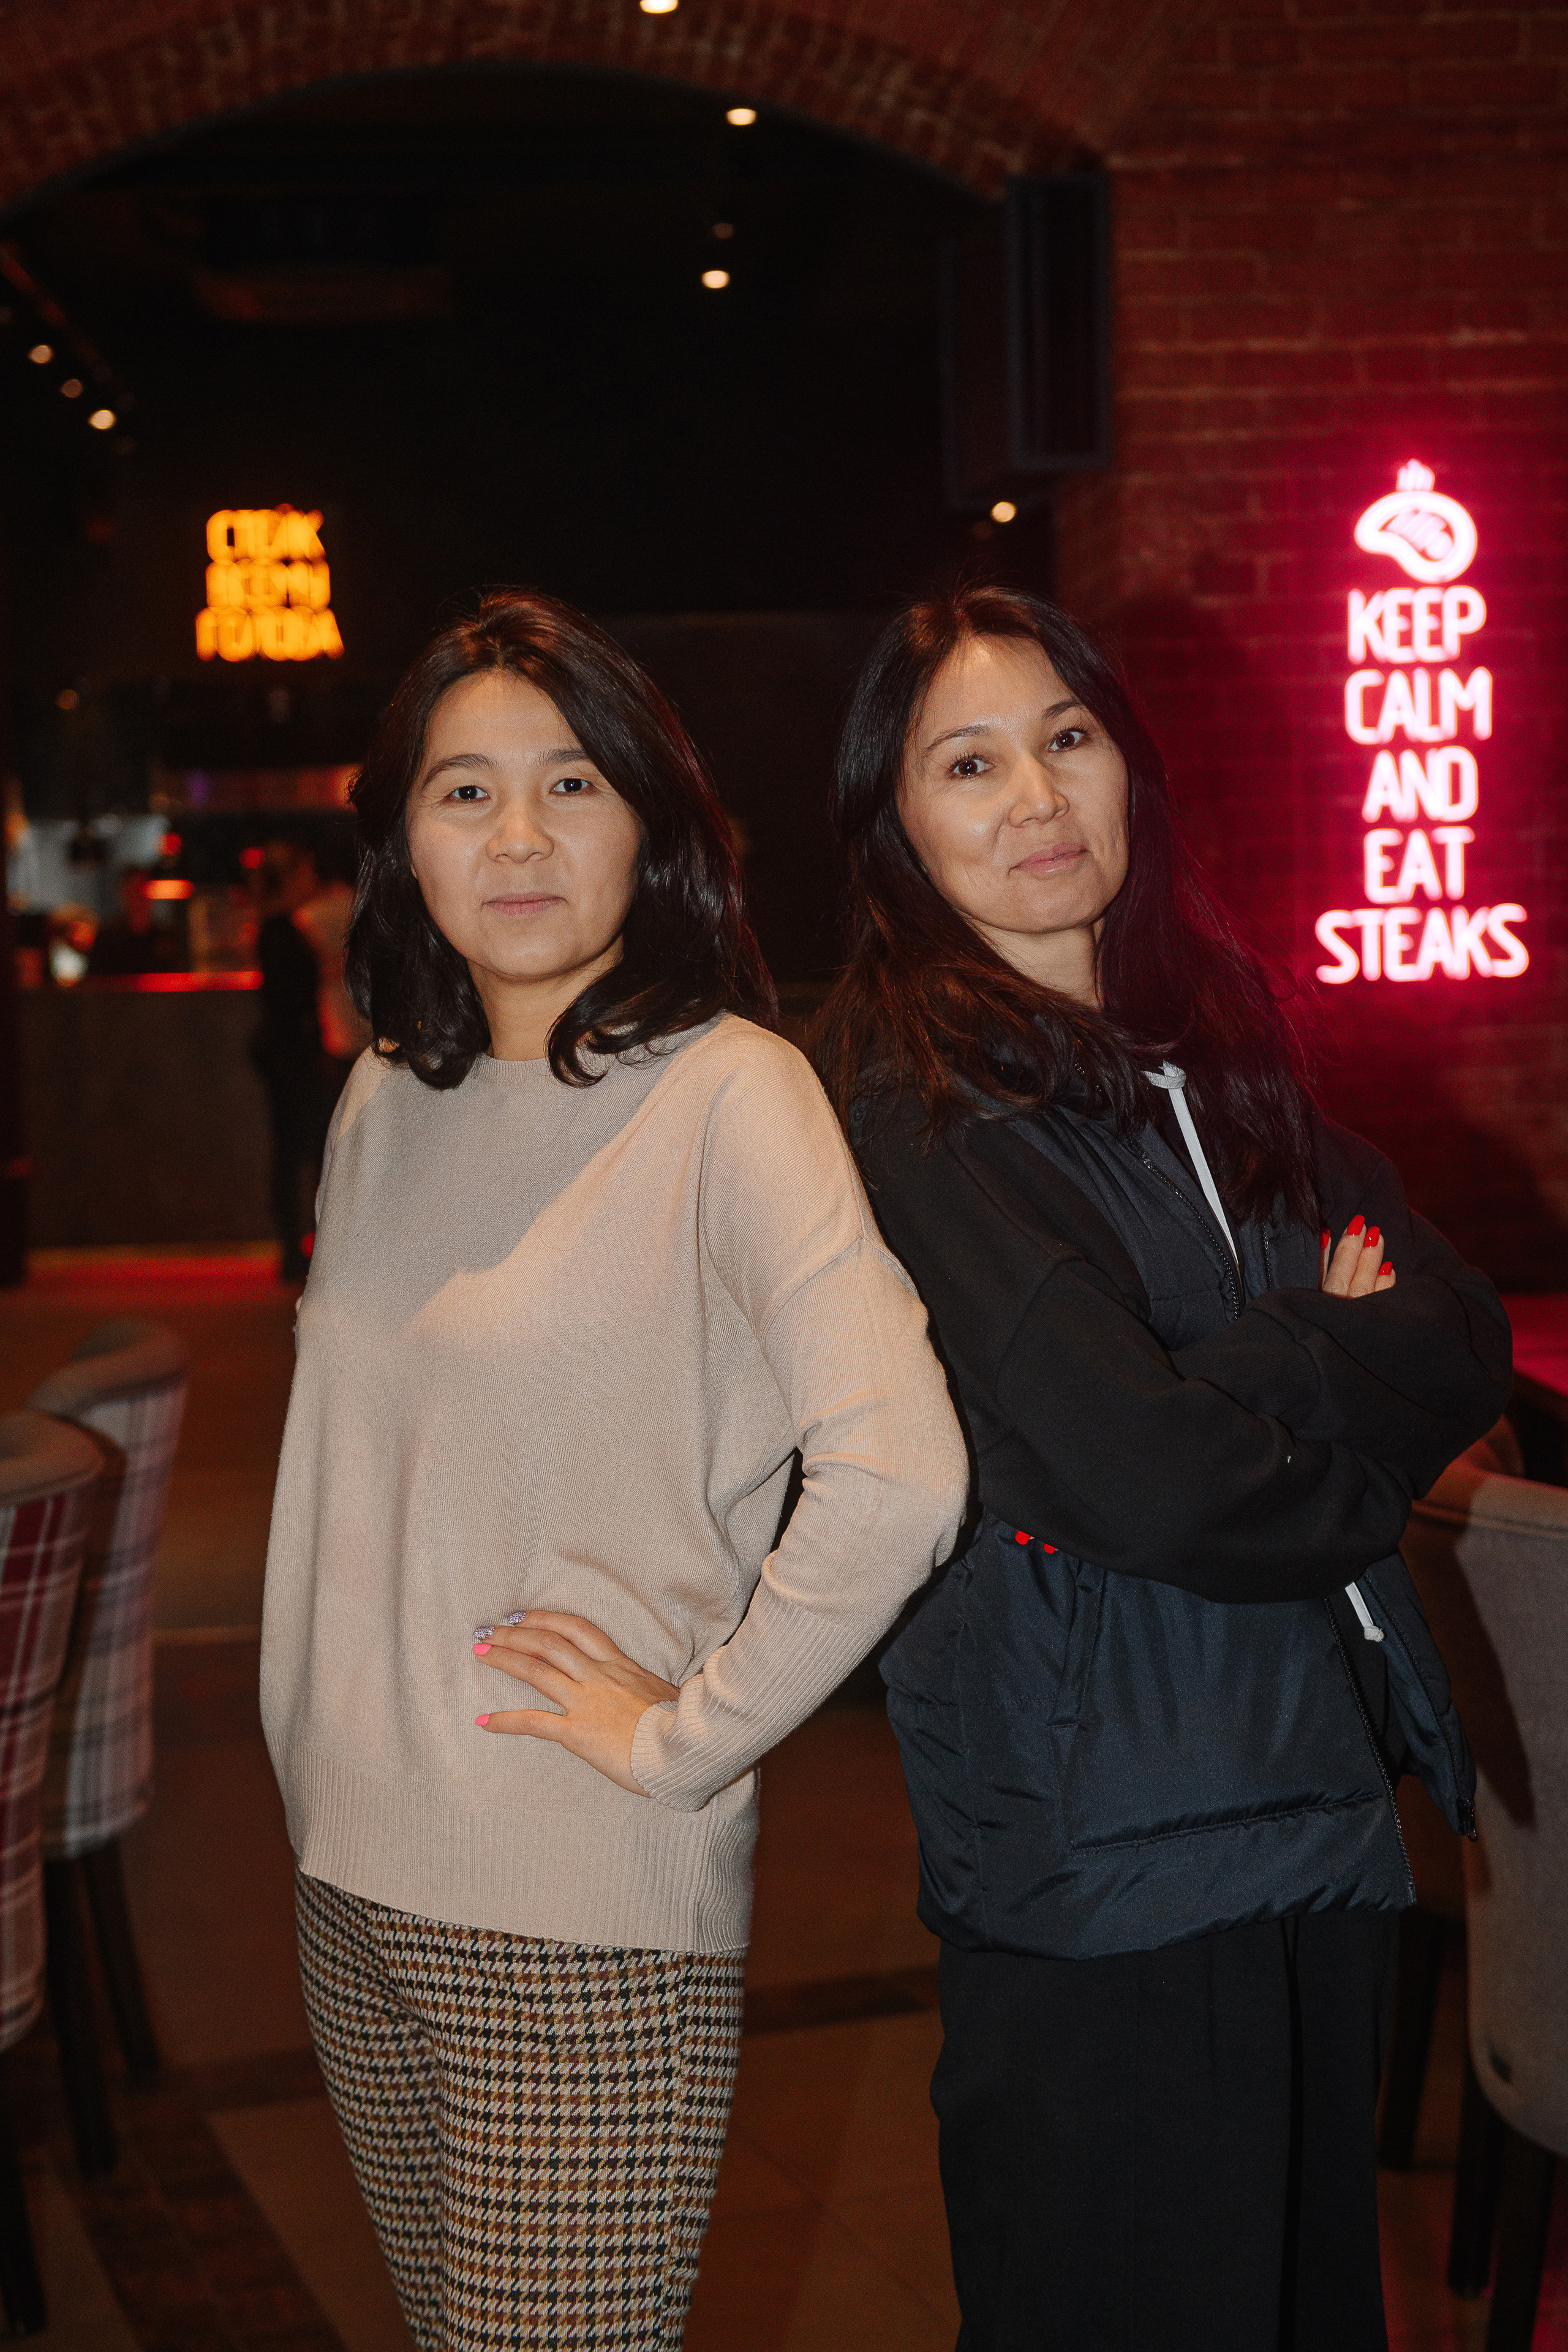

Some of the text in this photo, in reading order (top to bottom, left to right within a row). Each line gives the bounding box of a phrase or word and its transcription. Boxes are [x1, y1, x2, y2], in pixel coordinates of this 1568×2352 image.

[1348, 584, 1487, 664] KEEP
[1344, 666, 1493, 745] CALM
[1362, 745, 1479, 822] AND
[1363, 826, 1476, 903] EAT
[1314, 903, 1529, 984] STEAKS
